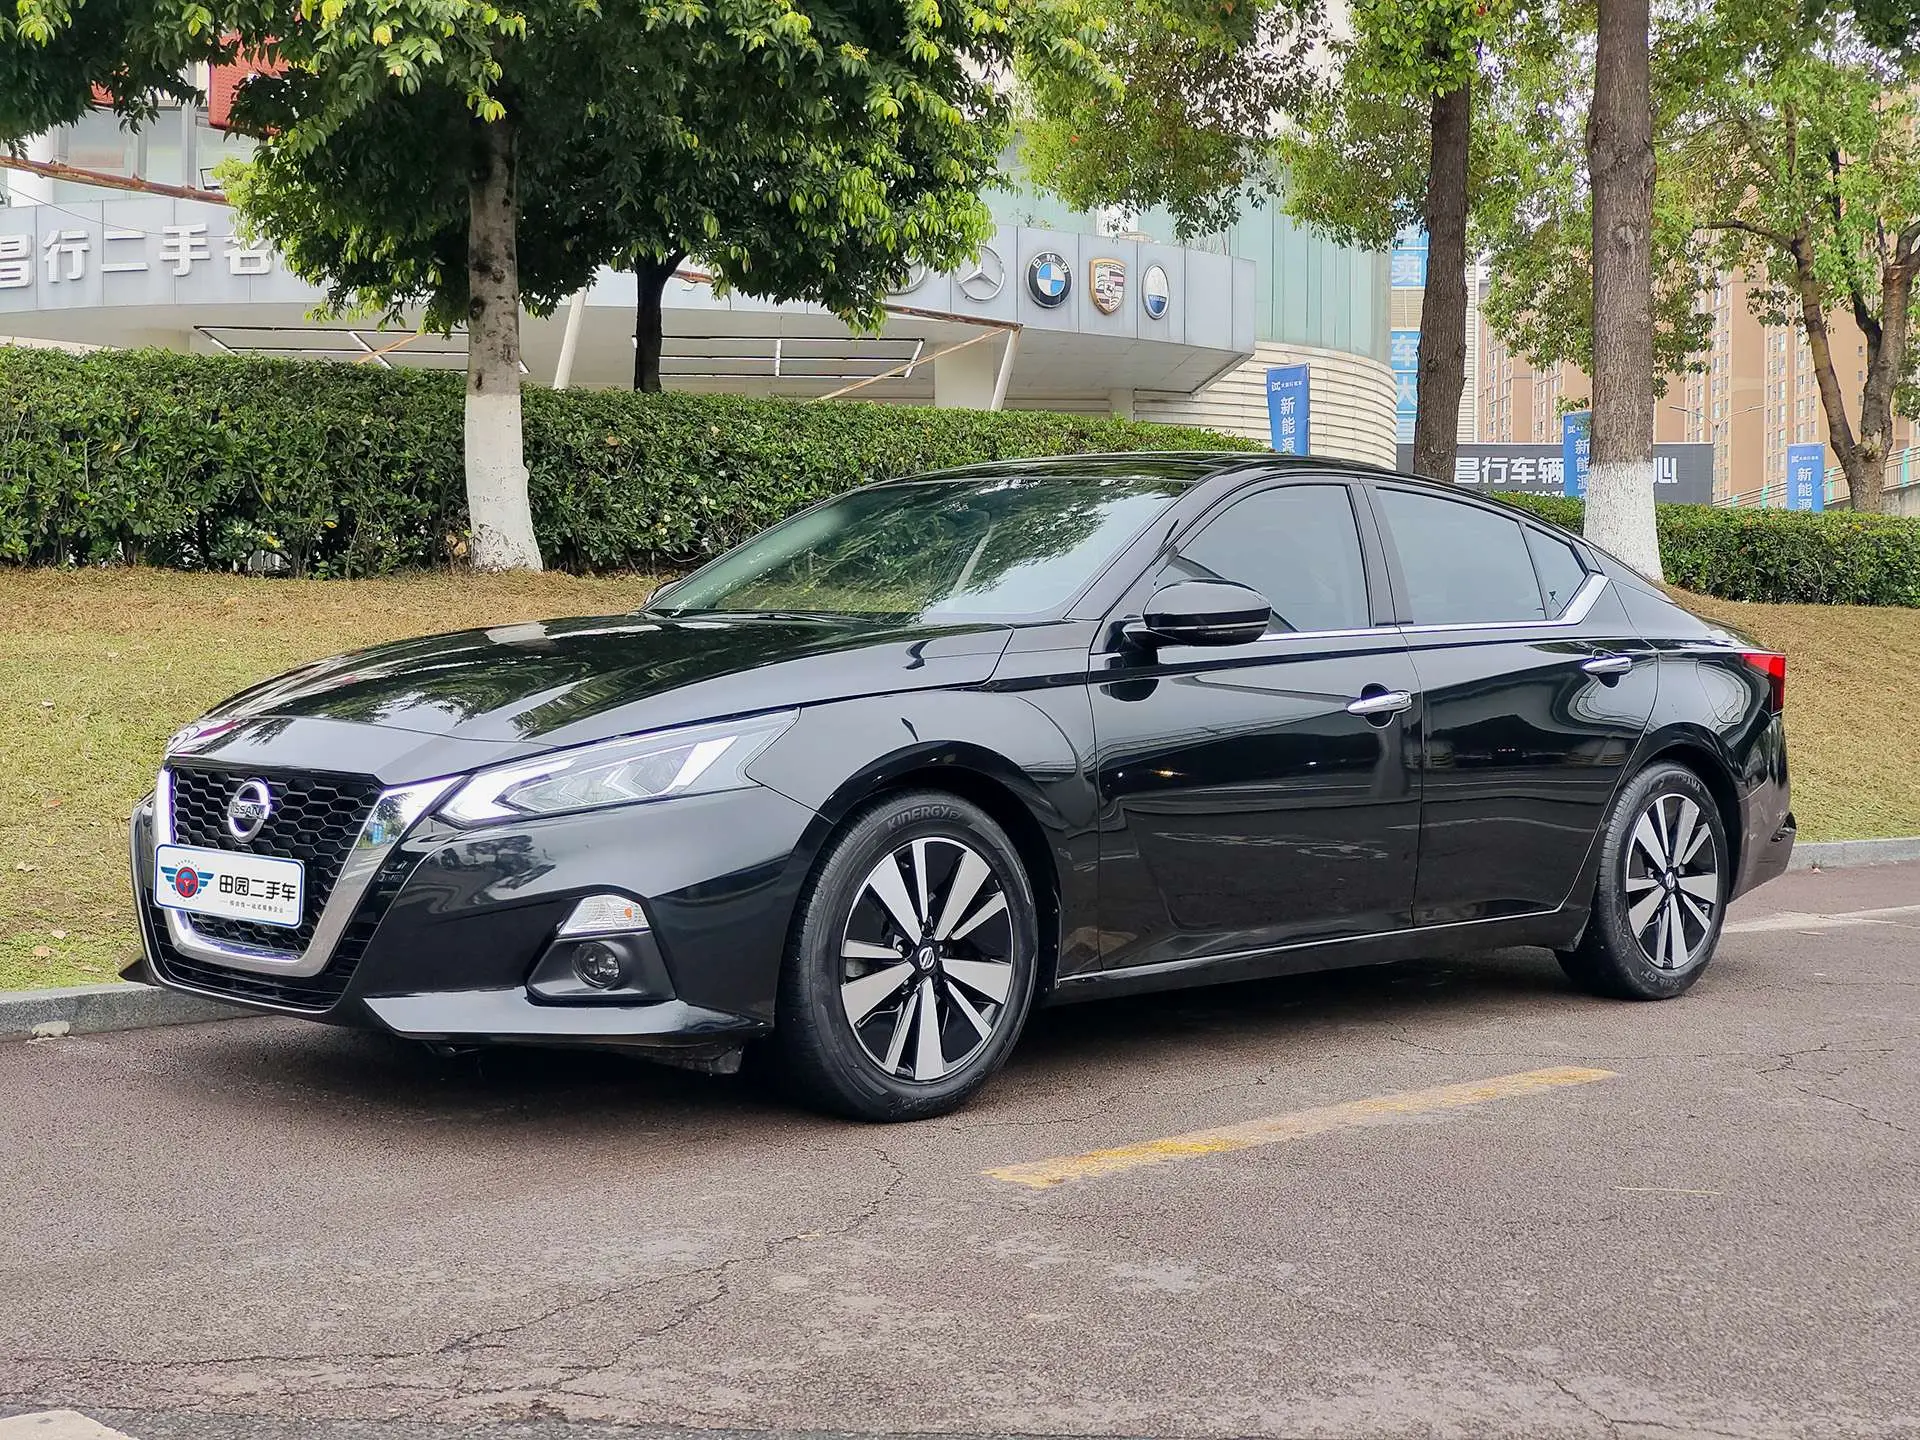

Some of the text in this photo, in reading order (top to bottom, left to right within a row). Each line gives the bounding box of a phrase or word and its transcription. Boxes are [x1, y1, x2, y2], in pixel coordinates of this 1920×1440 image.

[1032, 253, 1069, 274] BMW
[1280, 396, 1296, 453] 新能源
[1454, 456, 1564, 484] 昌行车辆
[1575, 438, 1590, 499] 新能源
[1797, 467, 1813, 511] 新能源
[887, 805, 951, 831] KINERGY
[219, 874, 297, 902] 田园二手车
